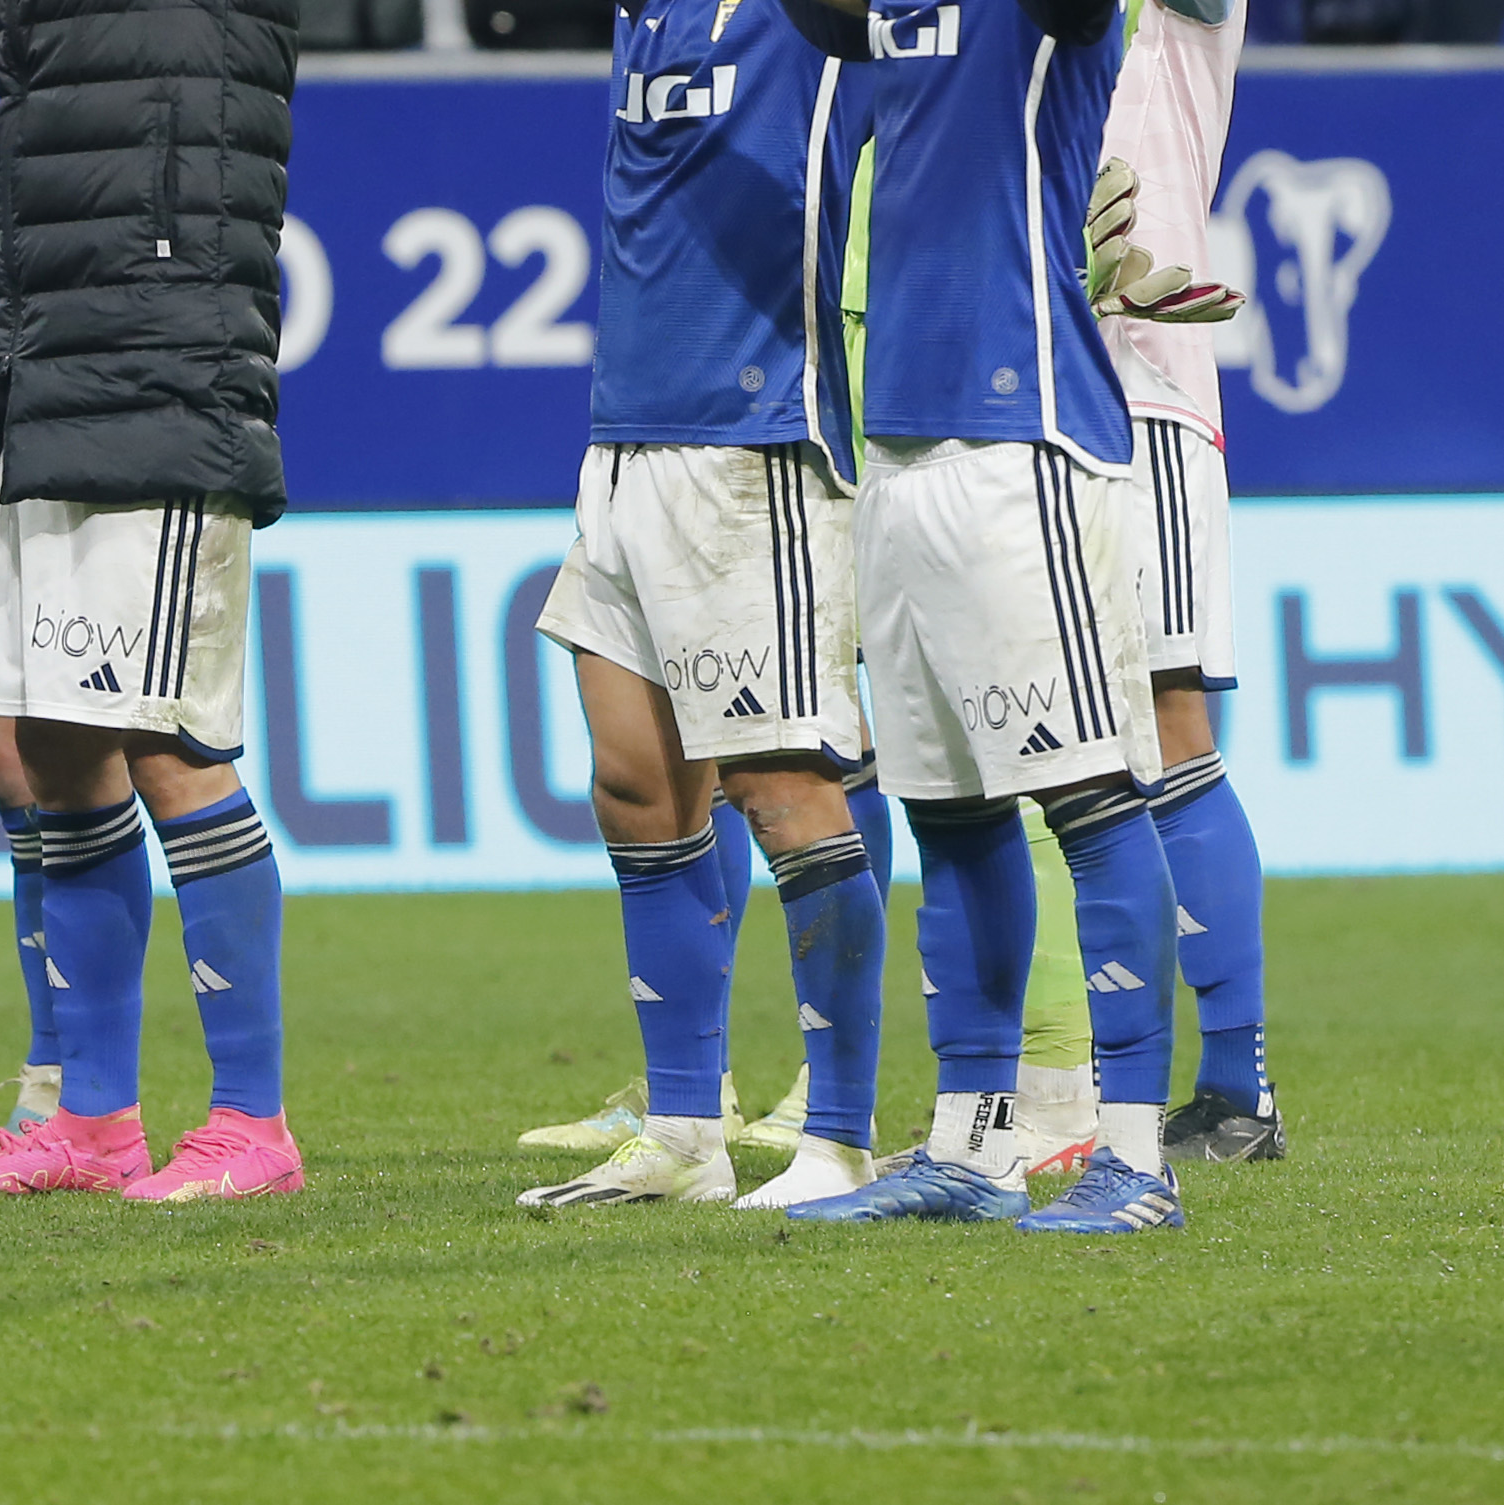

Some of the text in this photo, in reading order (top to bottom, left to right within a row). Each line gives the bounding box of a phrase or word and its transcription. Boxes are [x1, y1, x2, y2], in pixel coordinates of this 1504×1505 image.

[868, 5, 961, 60] IGI
[615, 64, 737, 124] IGI
[31, 603, 144, 659] biow
[659, 645, 771, 693] biow
[957, 676, 1057, 732] biow
